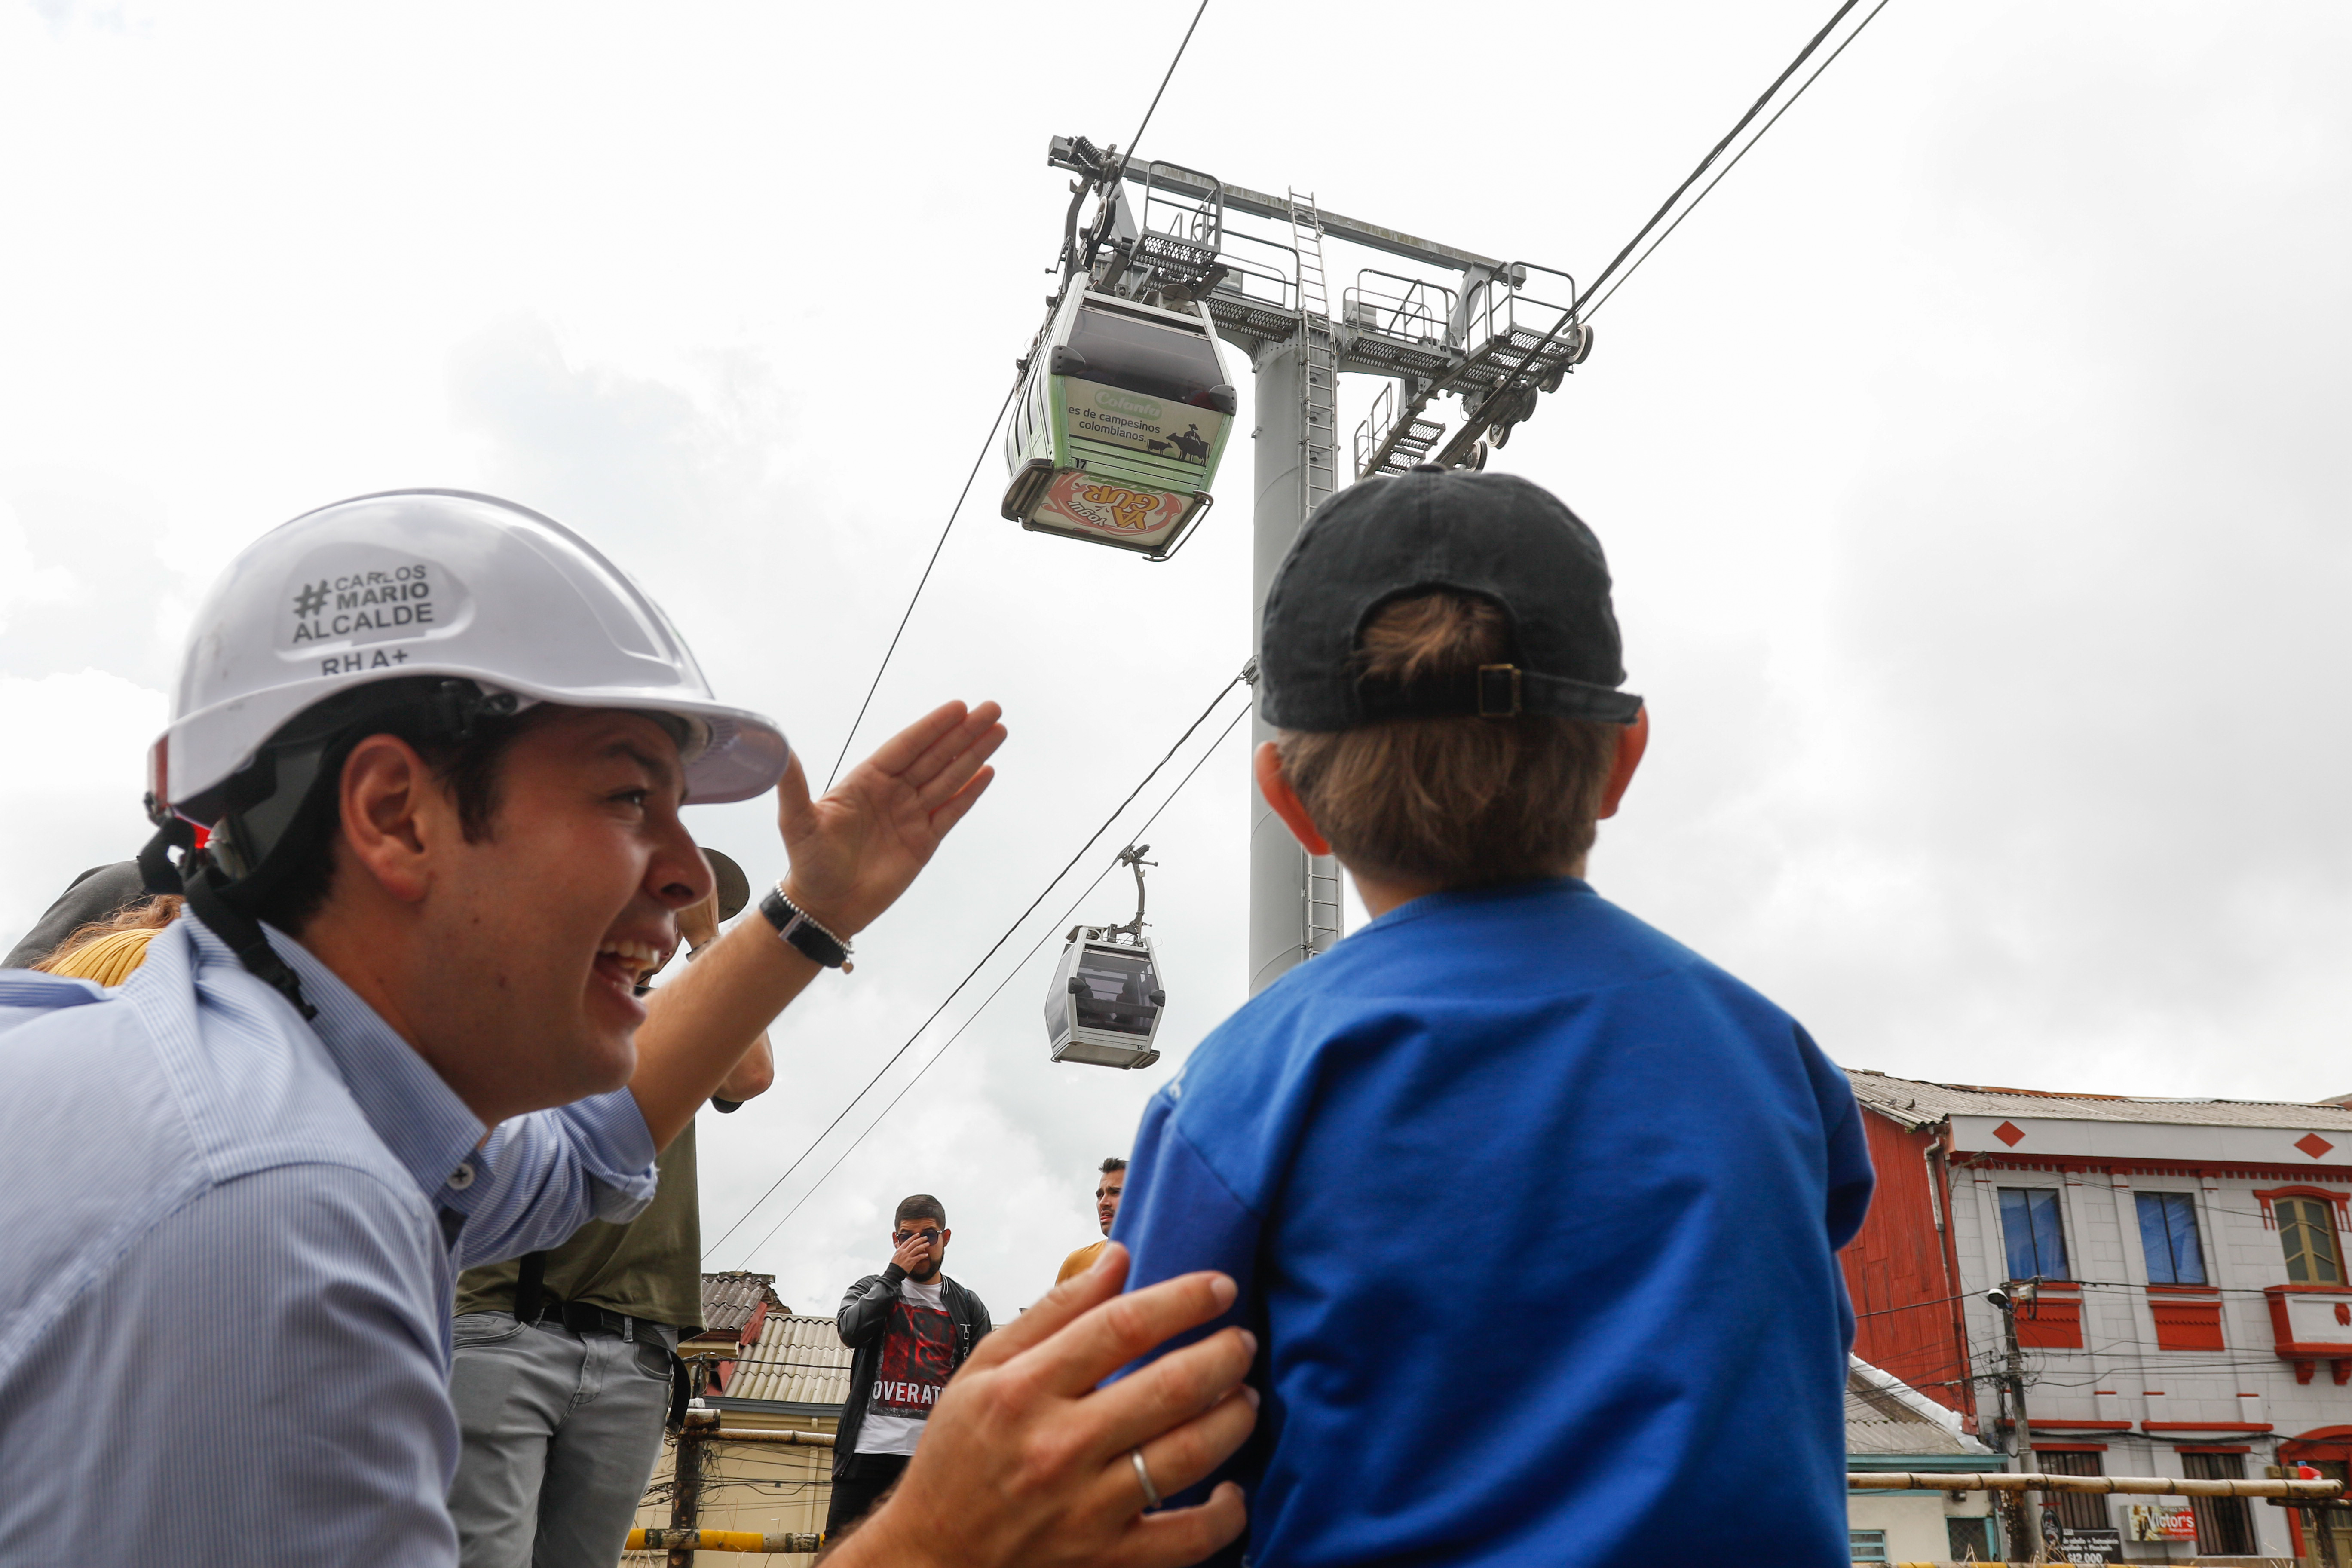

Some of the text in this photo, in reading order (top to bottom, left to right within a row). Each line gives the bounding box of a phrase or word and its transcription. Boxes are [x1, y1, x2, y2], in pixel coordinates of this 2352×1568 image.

[1096, 391, 1161, 416] Colanta
[1069, 407, 1161, 433] es de campesinos
[1079, 421, 1146, 442] colombianos.
[1075, 459, 1087, 469] 17
[1082, 485, 1160, 512] GUR
[1066, 501, 1107, 527] Yogur
[335, 564, 426, 592] CARLOS
[336, 582, 429, 610] MARIO
[292, 603, 433, 643] ALCALDE
[321, 649, 408, 676] RH A+
[872, 1380, 945, 1405] OVERAT
[2146, 1512, 2195, 1528] Victor's
[2067, 1553, 2103, 1564] $12.000
